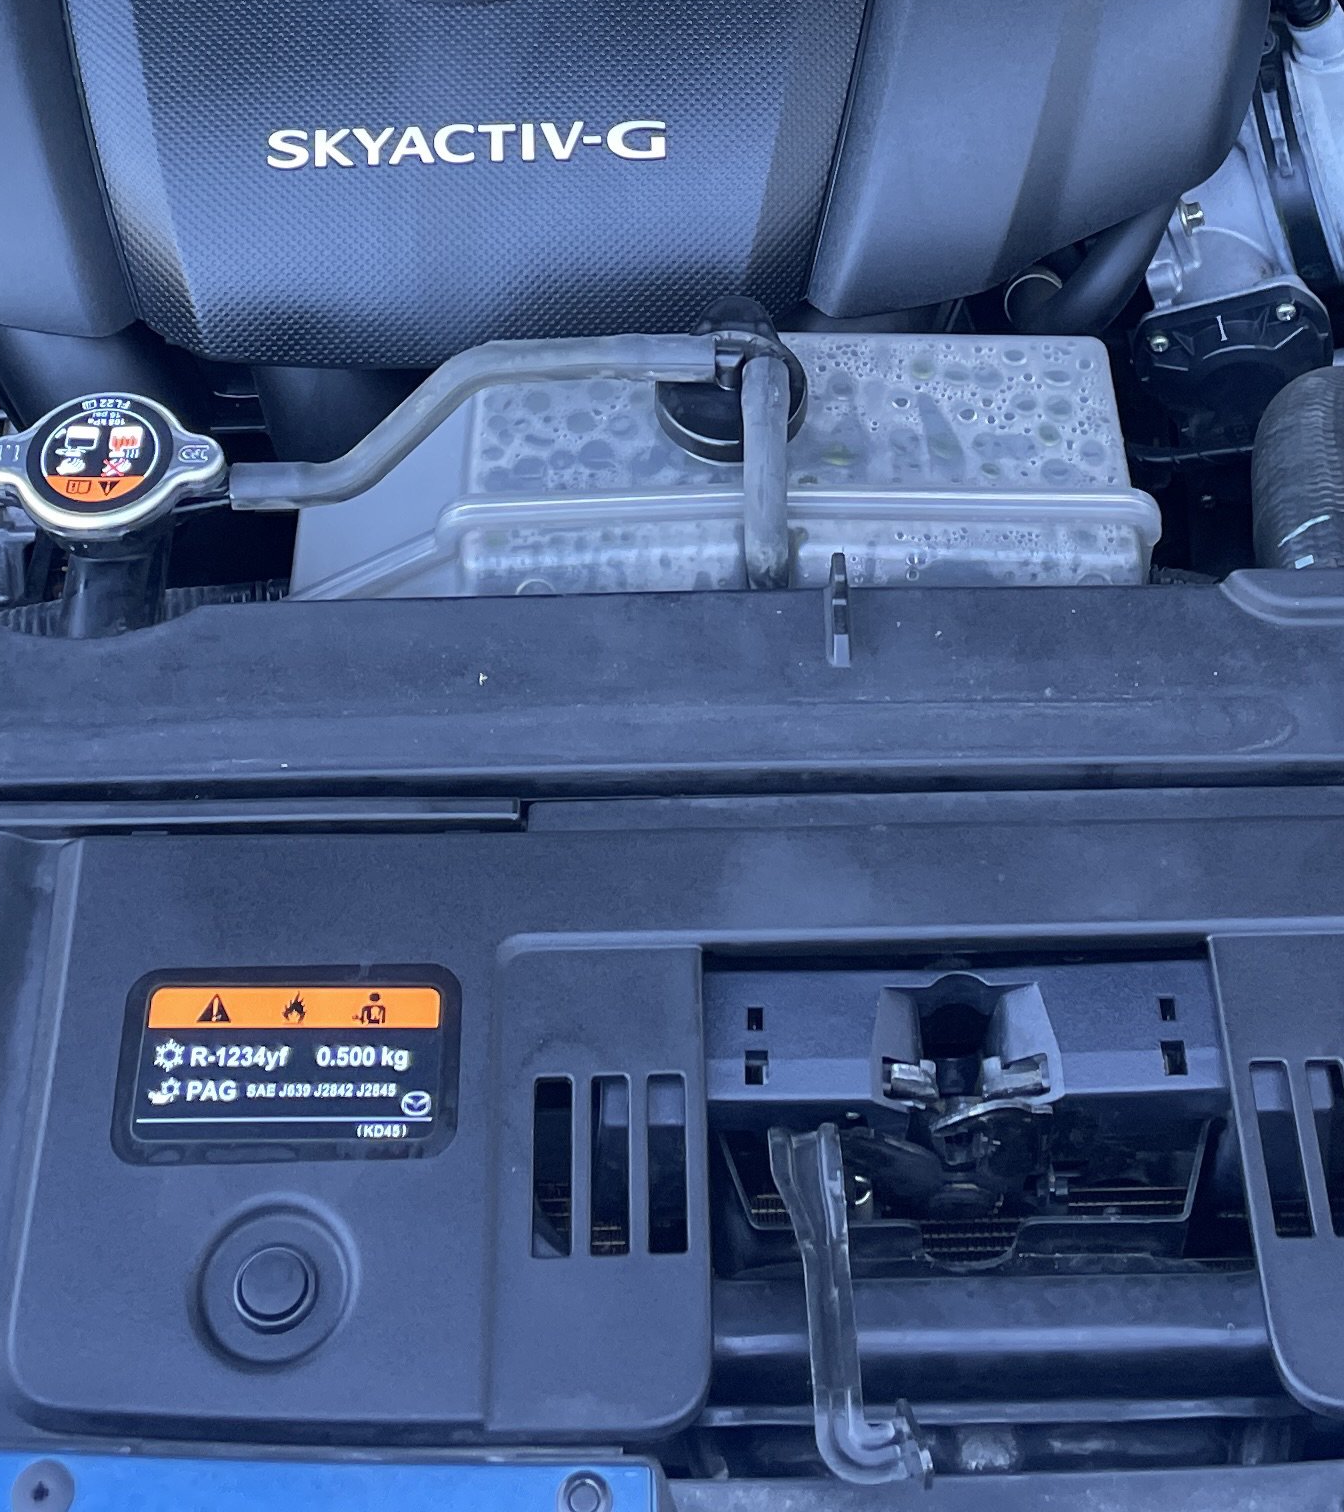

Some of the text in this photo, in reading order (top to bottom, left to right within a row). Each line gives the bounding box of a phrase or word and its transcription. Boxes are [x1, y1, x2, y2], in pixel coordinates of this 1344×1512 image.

[266, 119, 667, 170] SKYACTIV-G
[189, 1045, 410, 1071] R-1234yf 0.500 kg
[185, 1080, 237, 1102] PAG
[246, 1083, 276, 1098] SAE
[278, 1083, 311, 1098] J639
